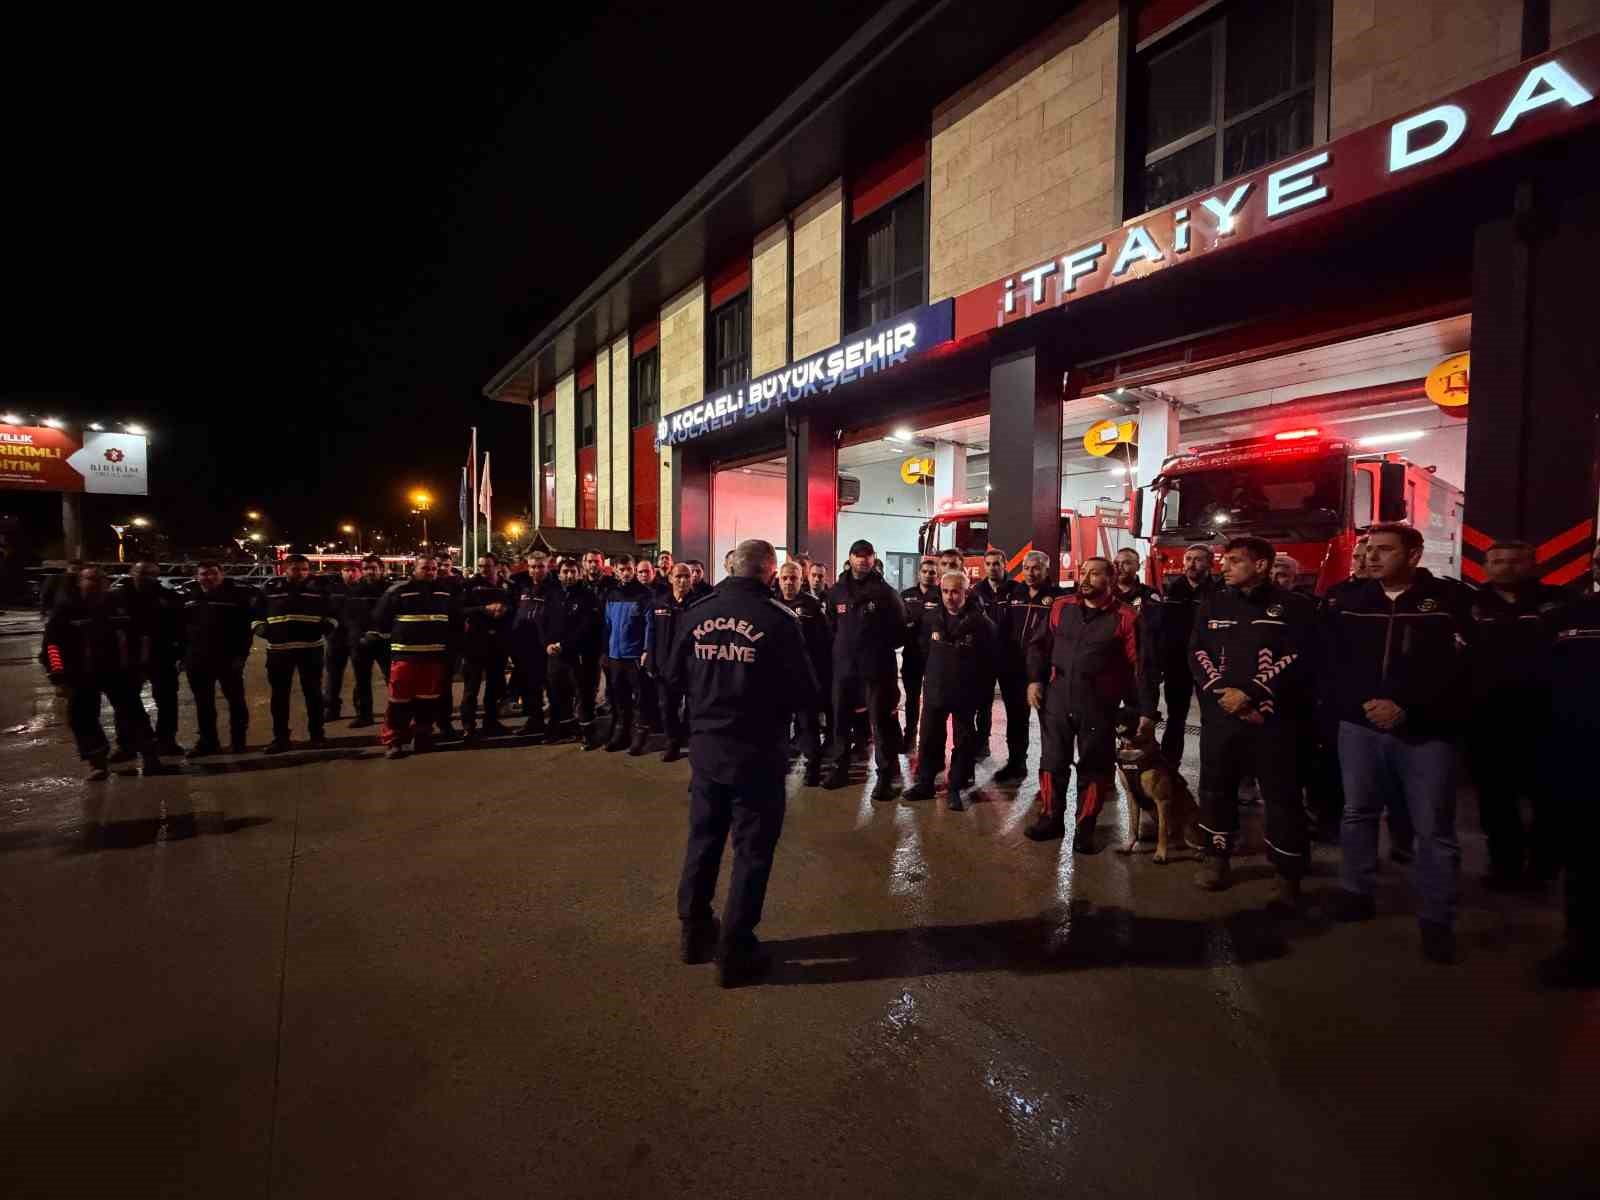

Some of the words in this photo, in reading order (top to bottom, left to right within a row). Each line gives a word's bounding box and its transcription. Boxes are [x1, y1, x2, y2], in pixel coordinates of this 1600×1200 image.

[1388, 61, 1593, 172] DA
[672, 392, 743, 430] KOCAELİ
[749, 322, 917, 404] BÜYÜKŞEHİR
